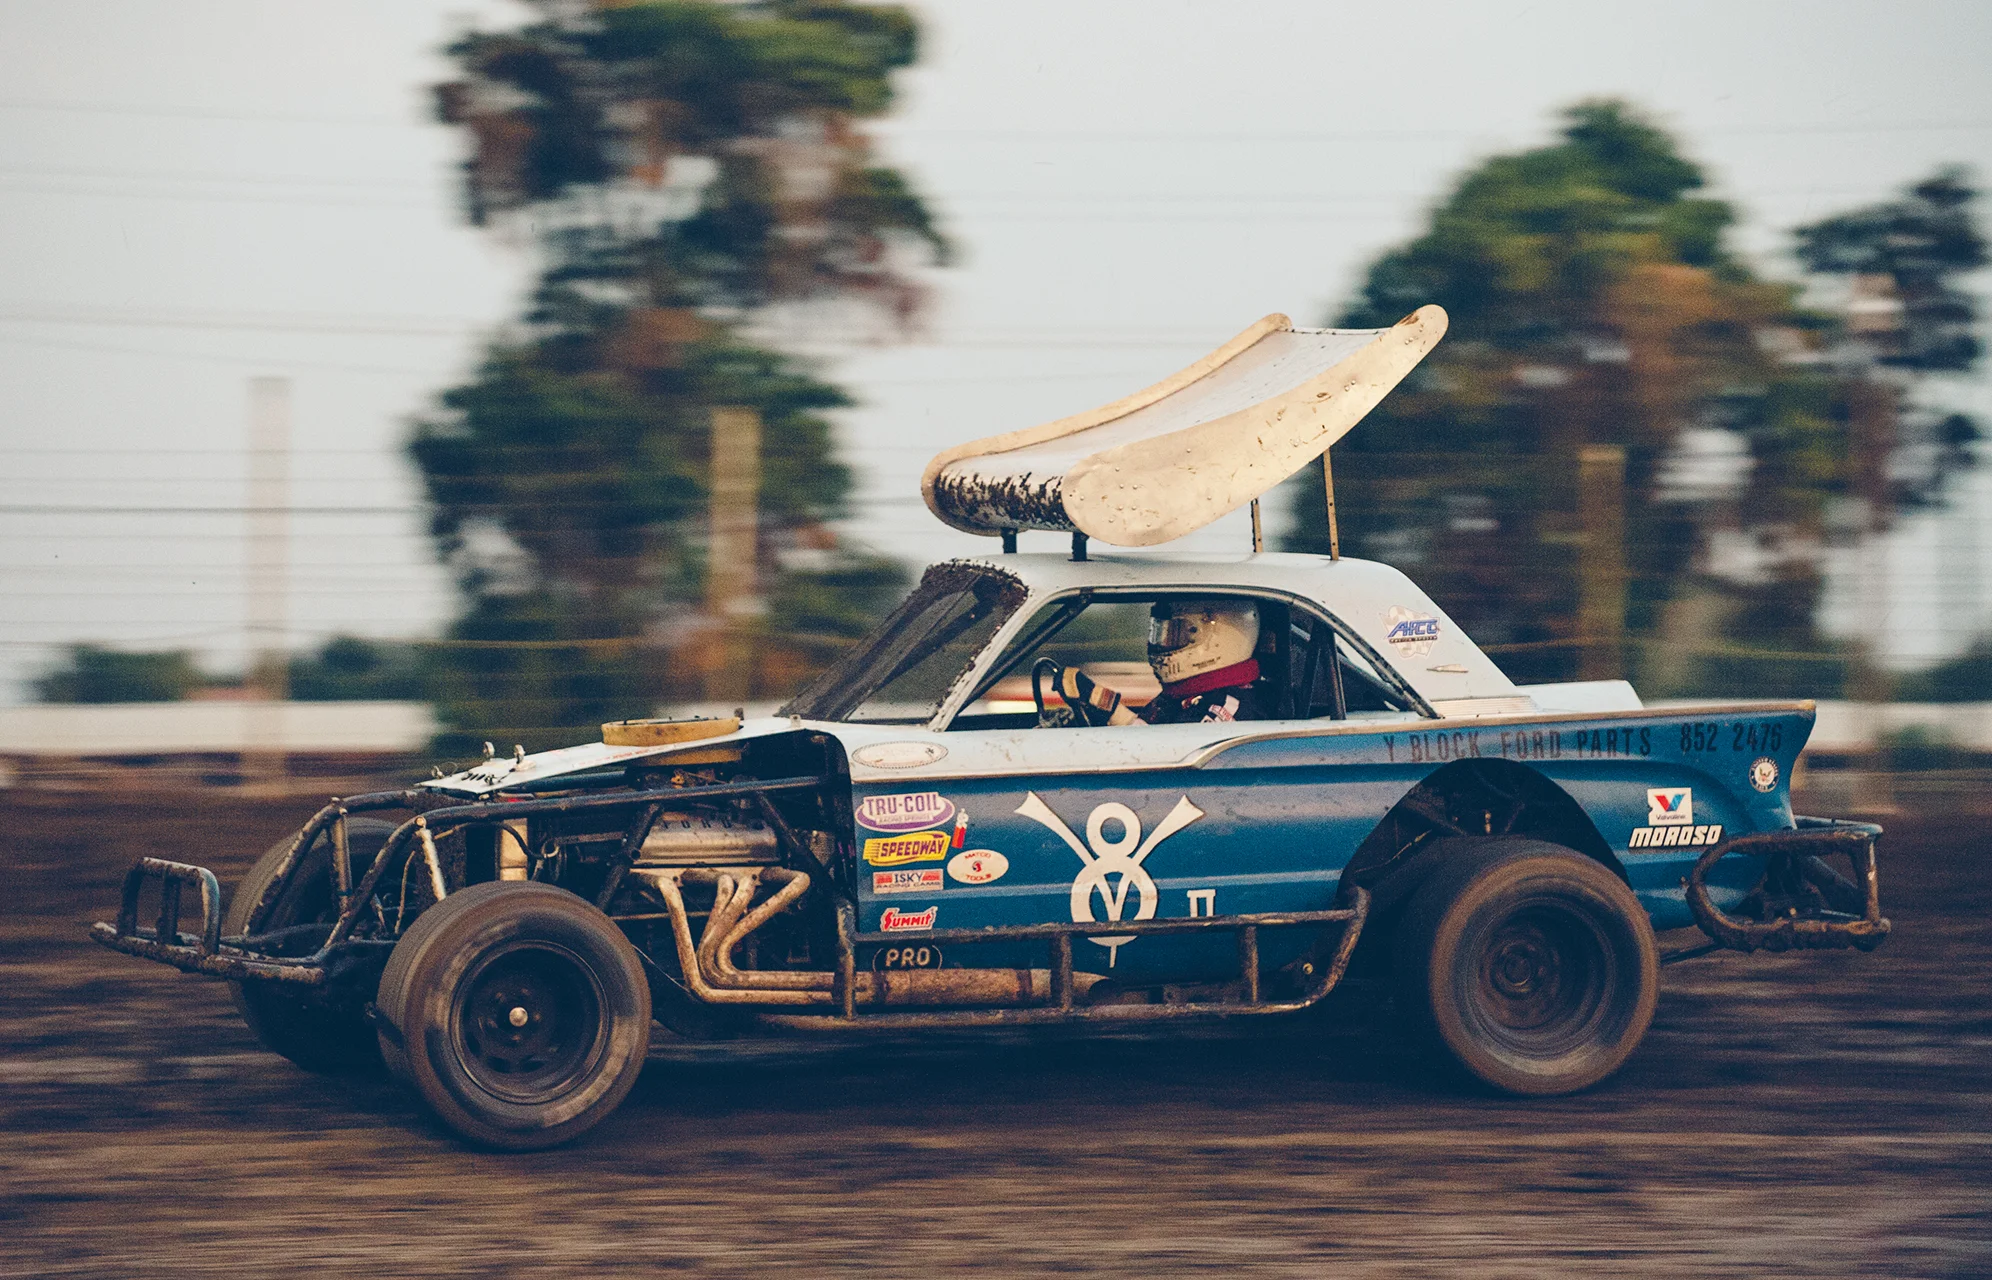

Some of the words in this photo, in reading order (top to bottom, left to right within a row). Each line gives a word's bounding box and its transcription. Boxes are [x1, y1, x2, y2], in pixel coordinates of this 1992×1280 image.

[1384, 735, 1395, 762] Y
[1410, 731, 1480, 762] BLOCK
[1501, 730, 1561, 759] FORD
[1576, 727, 1650, 758] PARTS
[1680, 723, 1717, 752] 852
[1732, 722, 1782, 752] 2476
[1629, 825, 1722, 848] MOROSO
[881, 840, 945, 857] SPEEDWAY
[894, 873, 922, 883] ISKY
[885, 947, 930, 967] PRO
